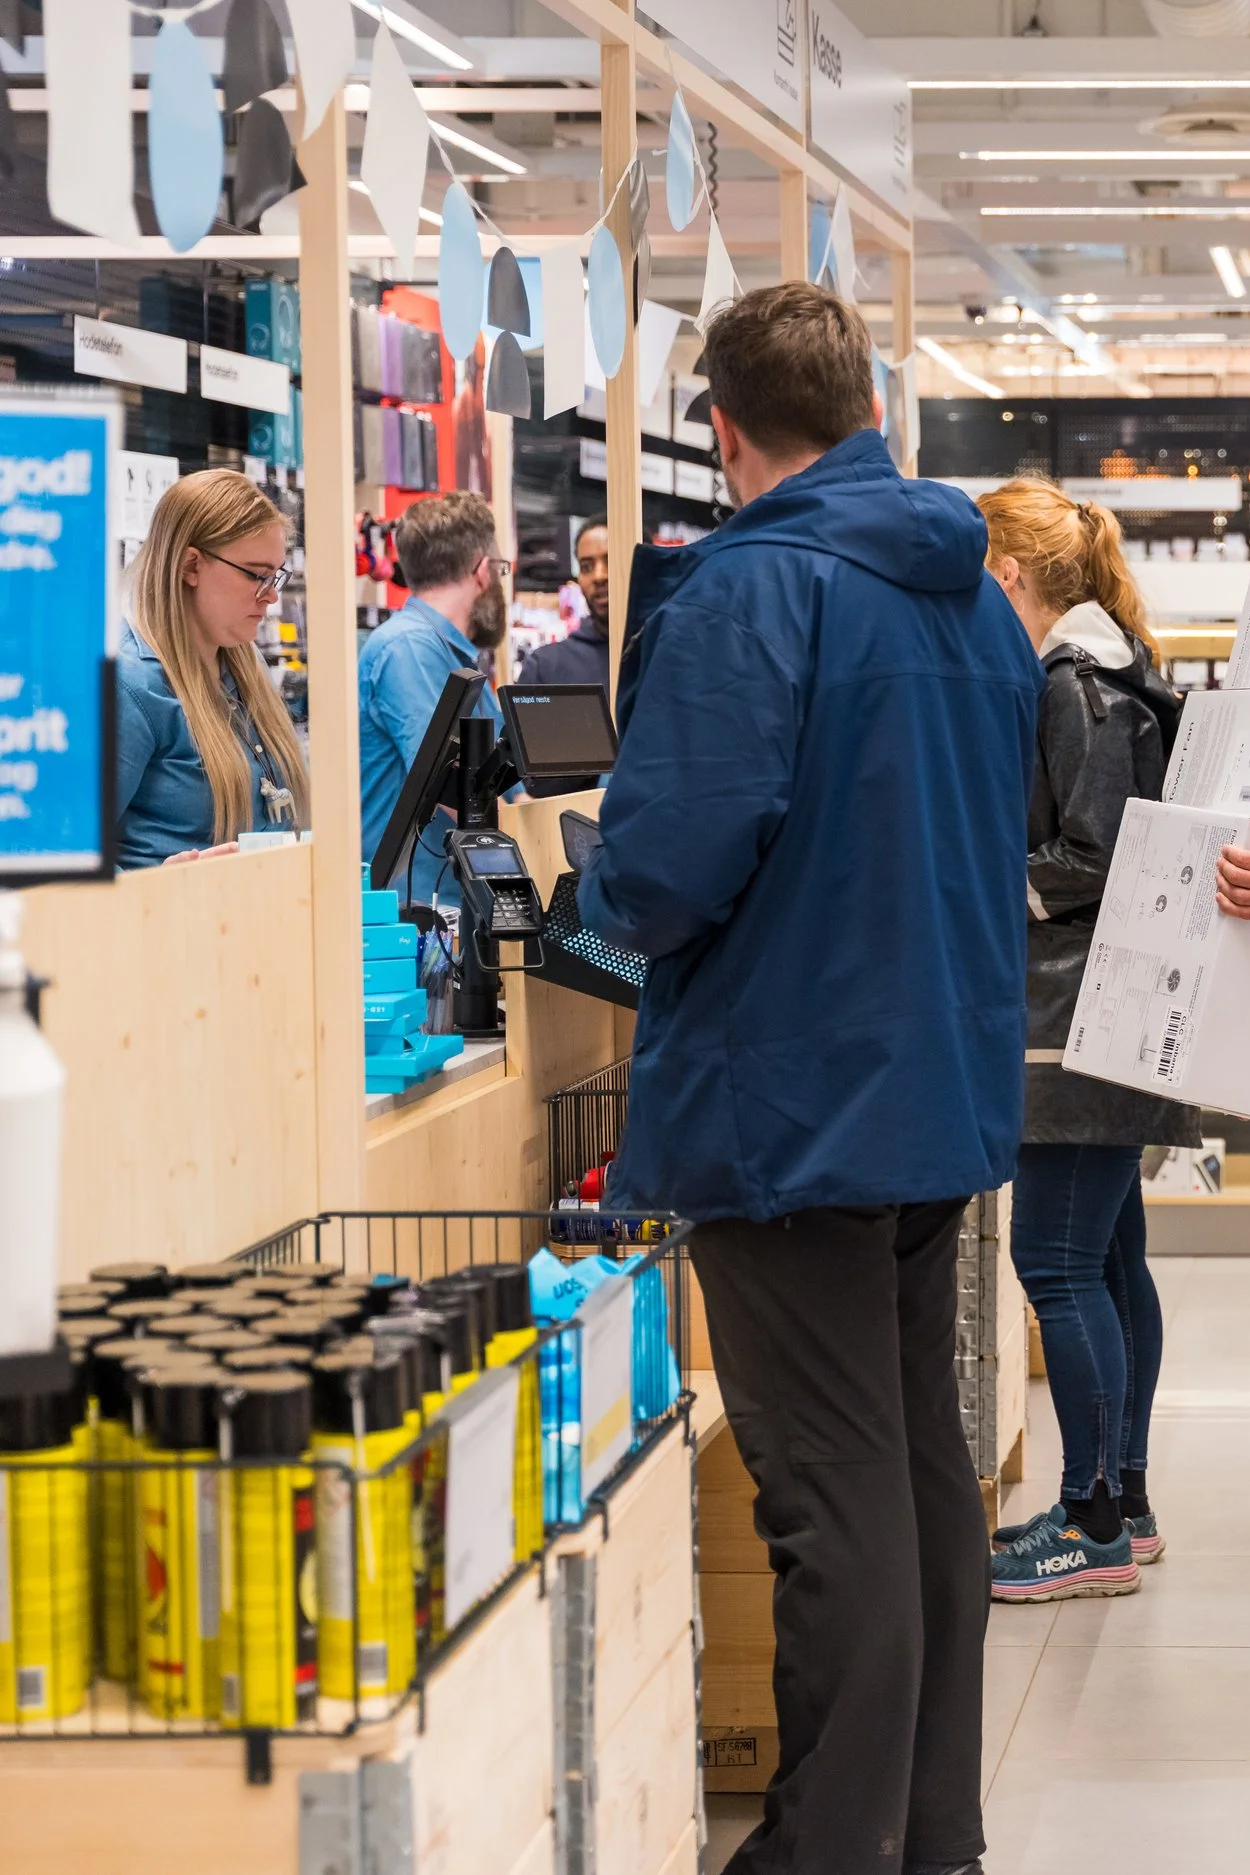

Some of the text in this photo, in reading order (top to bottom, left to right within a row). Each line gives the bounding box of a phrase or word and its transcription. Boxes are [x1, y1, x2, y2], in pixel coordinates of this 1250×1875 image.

[812, 9, 841, 89] Kasse
[1183, 721, 1195, 752] Fan
[1178, 1014, 1187, 1036] CLC
[1036, 1549, 1088, 1577] HOKA
